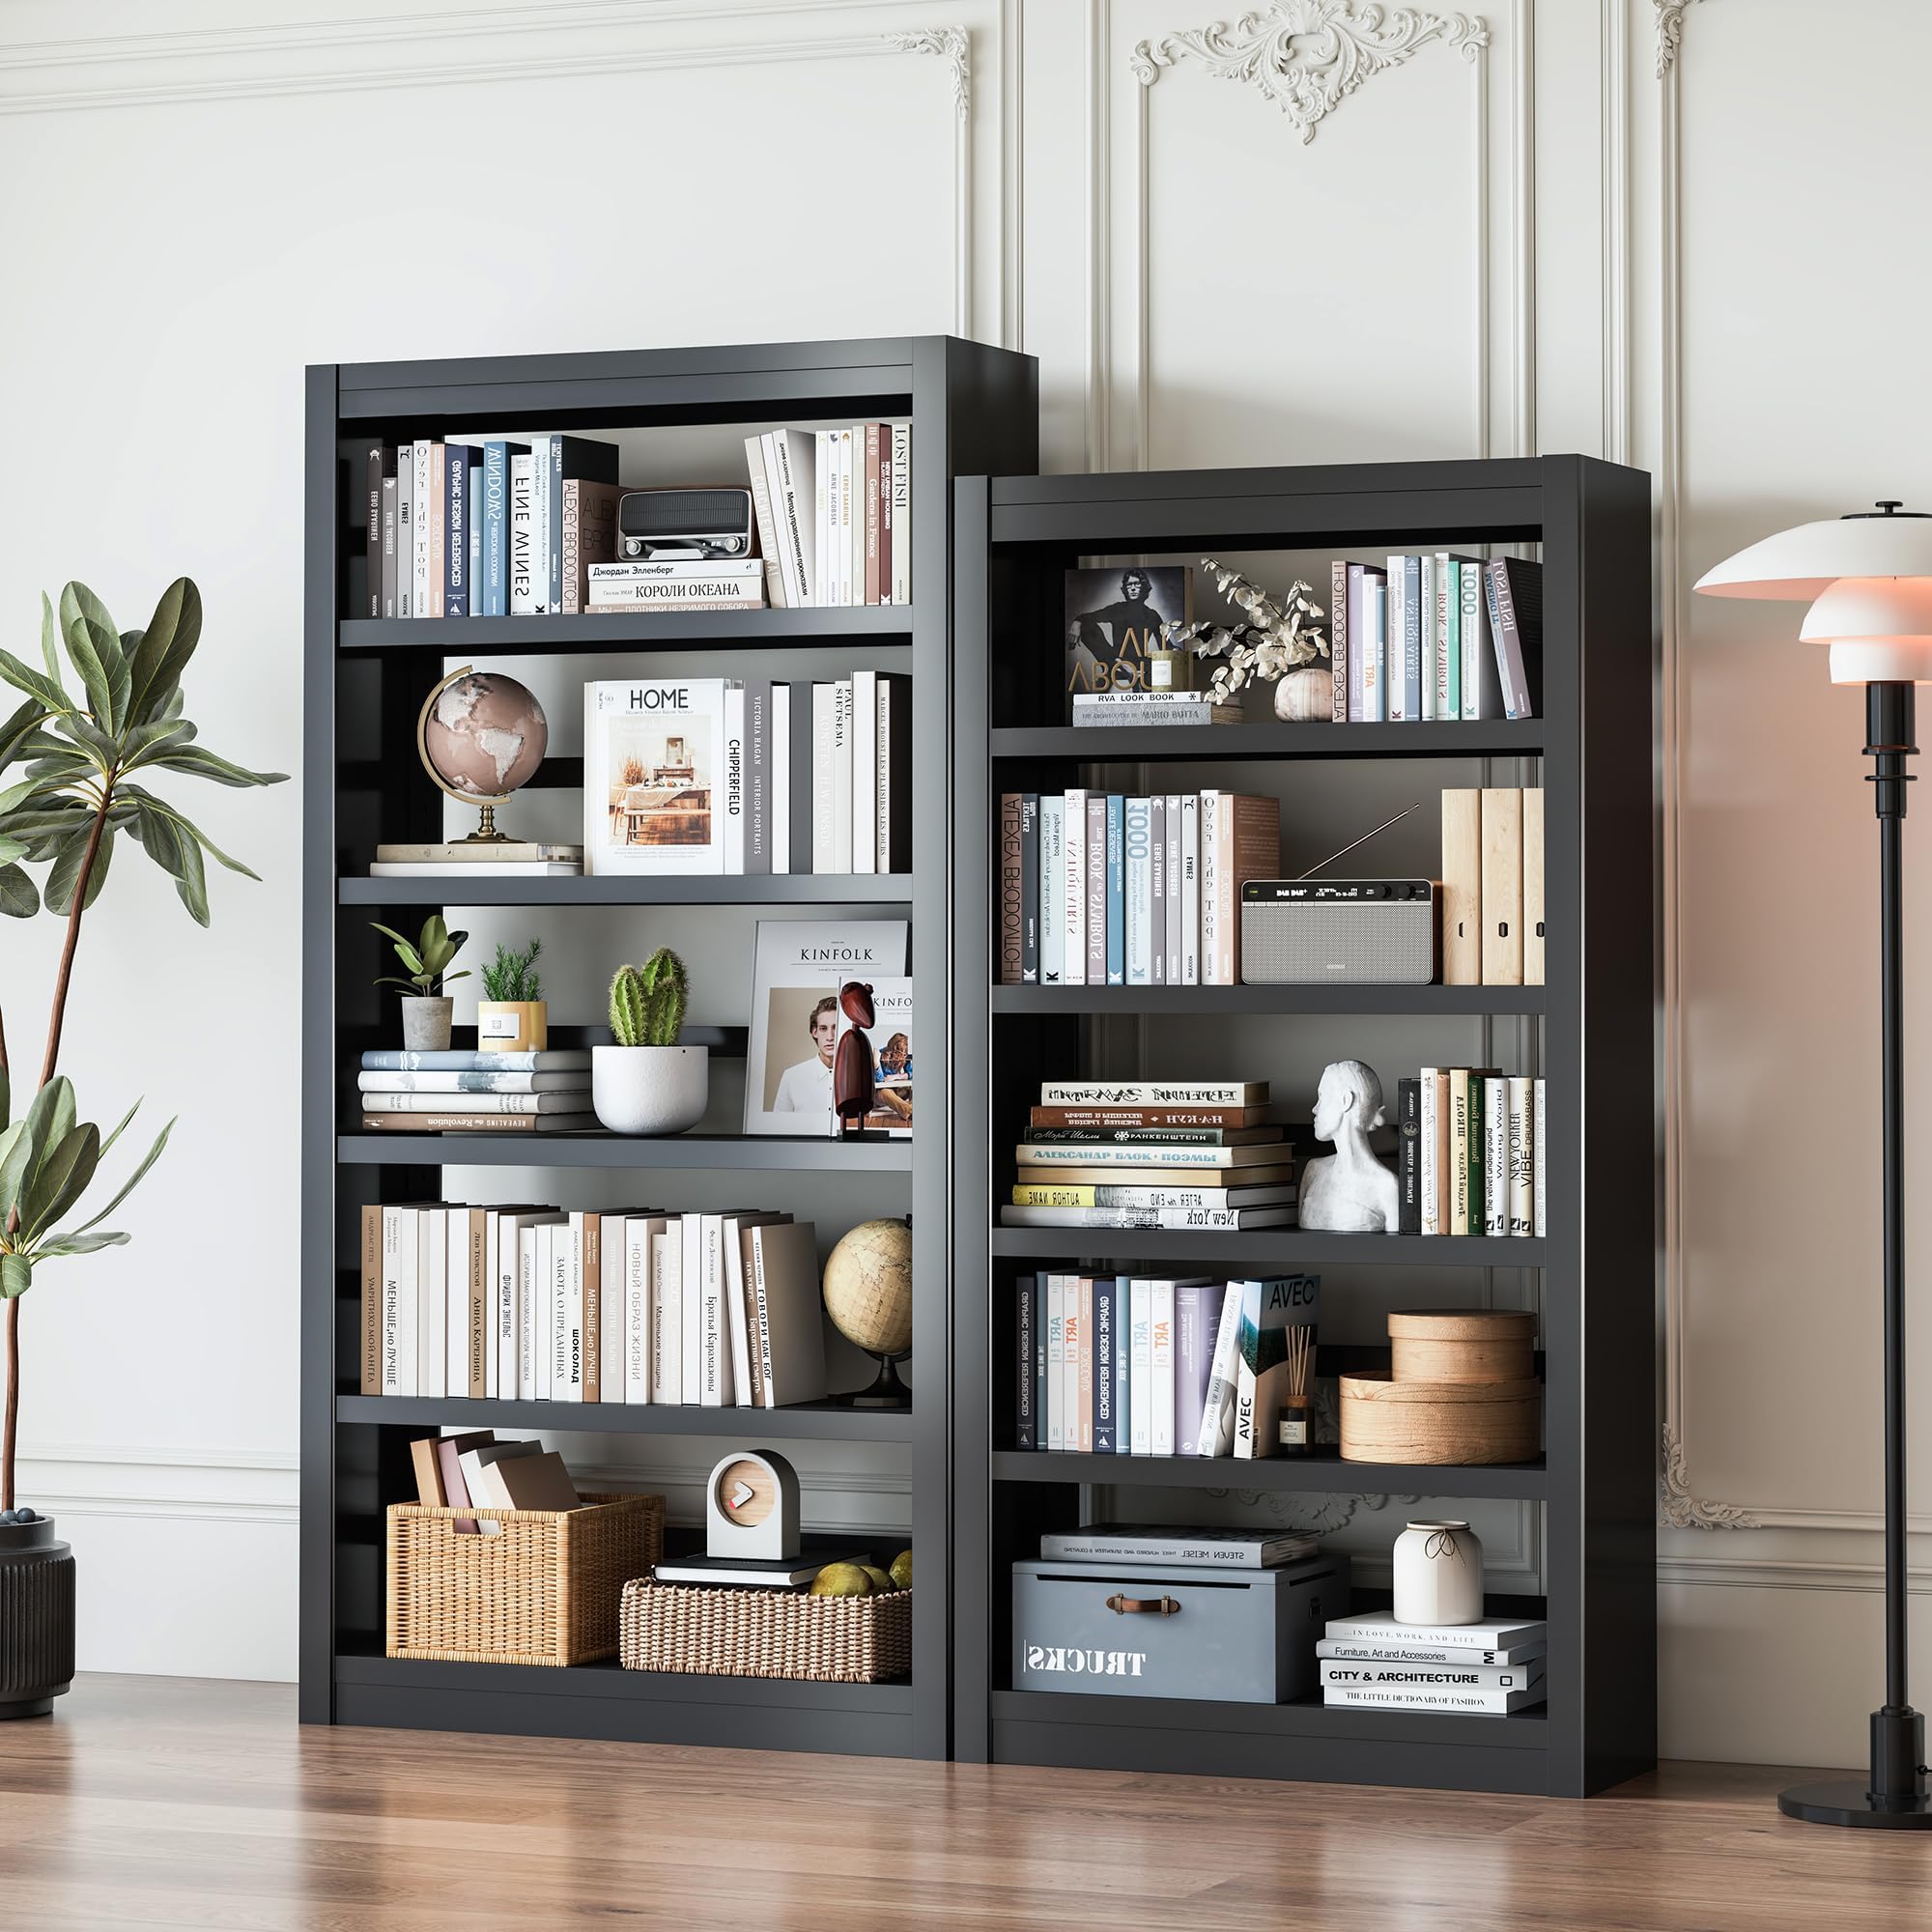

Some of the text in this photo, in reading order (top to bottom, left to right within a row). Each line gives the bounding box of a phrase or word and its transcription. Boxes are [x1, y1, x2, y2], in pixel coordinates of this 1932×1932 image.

[895, 429, 907, 508] LOST FISH
[786, 491, 796, 515] Метод
[869, 478, 878, 559] Gardens in France
[563, 483, 577, 609] ALEXEY BRODOVITCH
[593, 565, 674, 578] Джордан Элленберг
[636, 582, 741, 598] КОРОЛИ ОКЕАНА
[630, 688, 688, 710] HOME
[1098, 693, 1175, 703] RVA LOOK BOOK
[836, 688, 844, 749] SIETSEMA
[728, 739, 741, 815] CHIPPERFIELD
[801, 949, 873, 960] KINFOLK
[427, 1118, 471, 1127] Revolution
[487, 1119, 526, 1127] REVEALING
[1033, 1150, 1217, 1163] АЛЕКСАНДР БЛОК ПОЭМЫ
[1520, 1150, 1532, 1187] VIBE
[502, 1274, 511, 1338] ФРИДРИХ ЭНГЕЛЬС
[1269, 1279, 1315, 1310] AVEC
[557, 1256, 565, 1379] ЗАБОТА О ПРЕДАННЫХ
[632, 1243, 641, 1381] НОВЫЙ ОБРАЗ ЖИЗНИ
[757, 1289, 768, 1333] ГОВОРИ
[707, 1295, 717, 1392] Братья Карамазовы
[762, 1334, 770, 1359] КАК
[386, 1346, 397, 1386] ЛУЧШЕ
[587, 1350, 596, 1386] ЛУЧШЕ
[1239, 1397, 1251, 1440] AVEC
[1365, 1631, 1394, 1639] LOVE,
[1335, 1647, 1447, 1661] Furniture, Art and Accessories
[1329, 1671, 1479, 1684] CITY & ARCHITECTURE
[1345, 1691, 1485, 1706] THE LITTLE DICTIONARY OF FASHION
